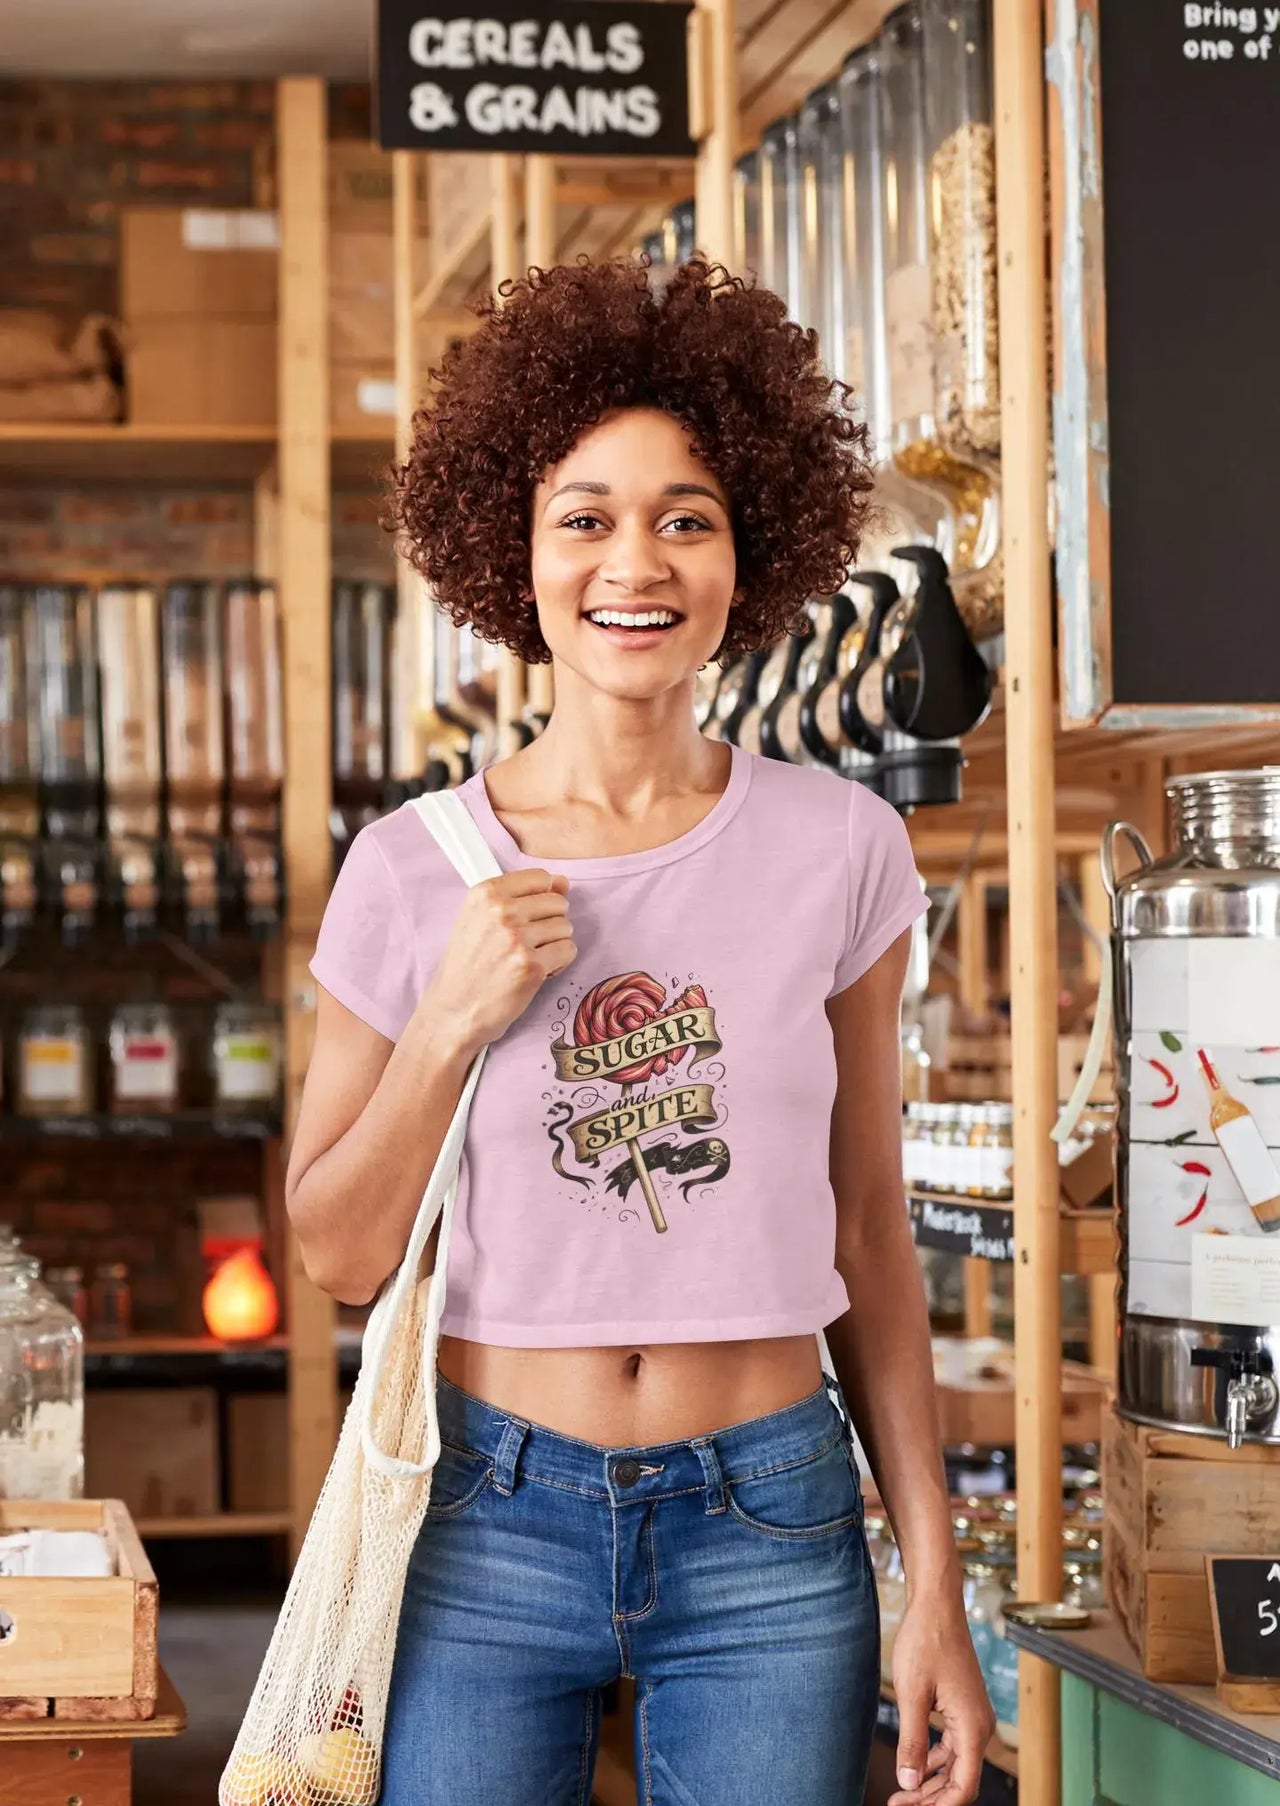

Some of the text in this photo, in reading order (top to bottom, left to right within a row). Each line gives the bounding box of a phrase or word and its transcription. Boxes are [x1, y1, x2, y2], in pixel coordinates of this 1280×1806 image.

[1184, 0, 1280, 34] Bring y
[409, 18, 643, 73] CEREALS
[1183, 33, 1273, 61] one of
[409, 82, 661, 137] & GRAINS
[573, 1013, 706, 1076] SUGAR
[584, 1089, 698, 1149] SPITE
[610, 1086, 650, 1112] and
[1258, 1599, 1280, 1636] 5
